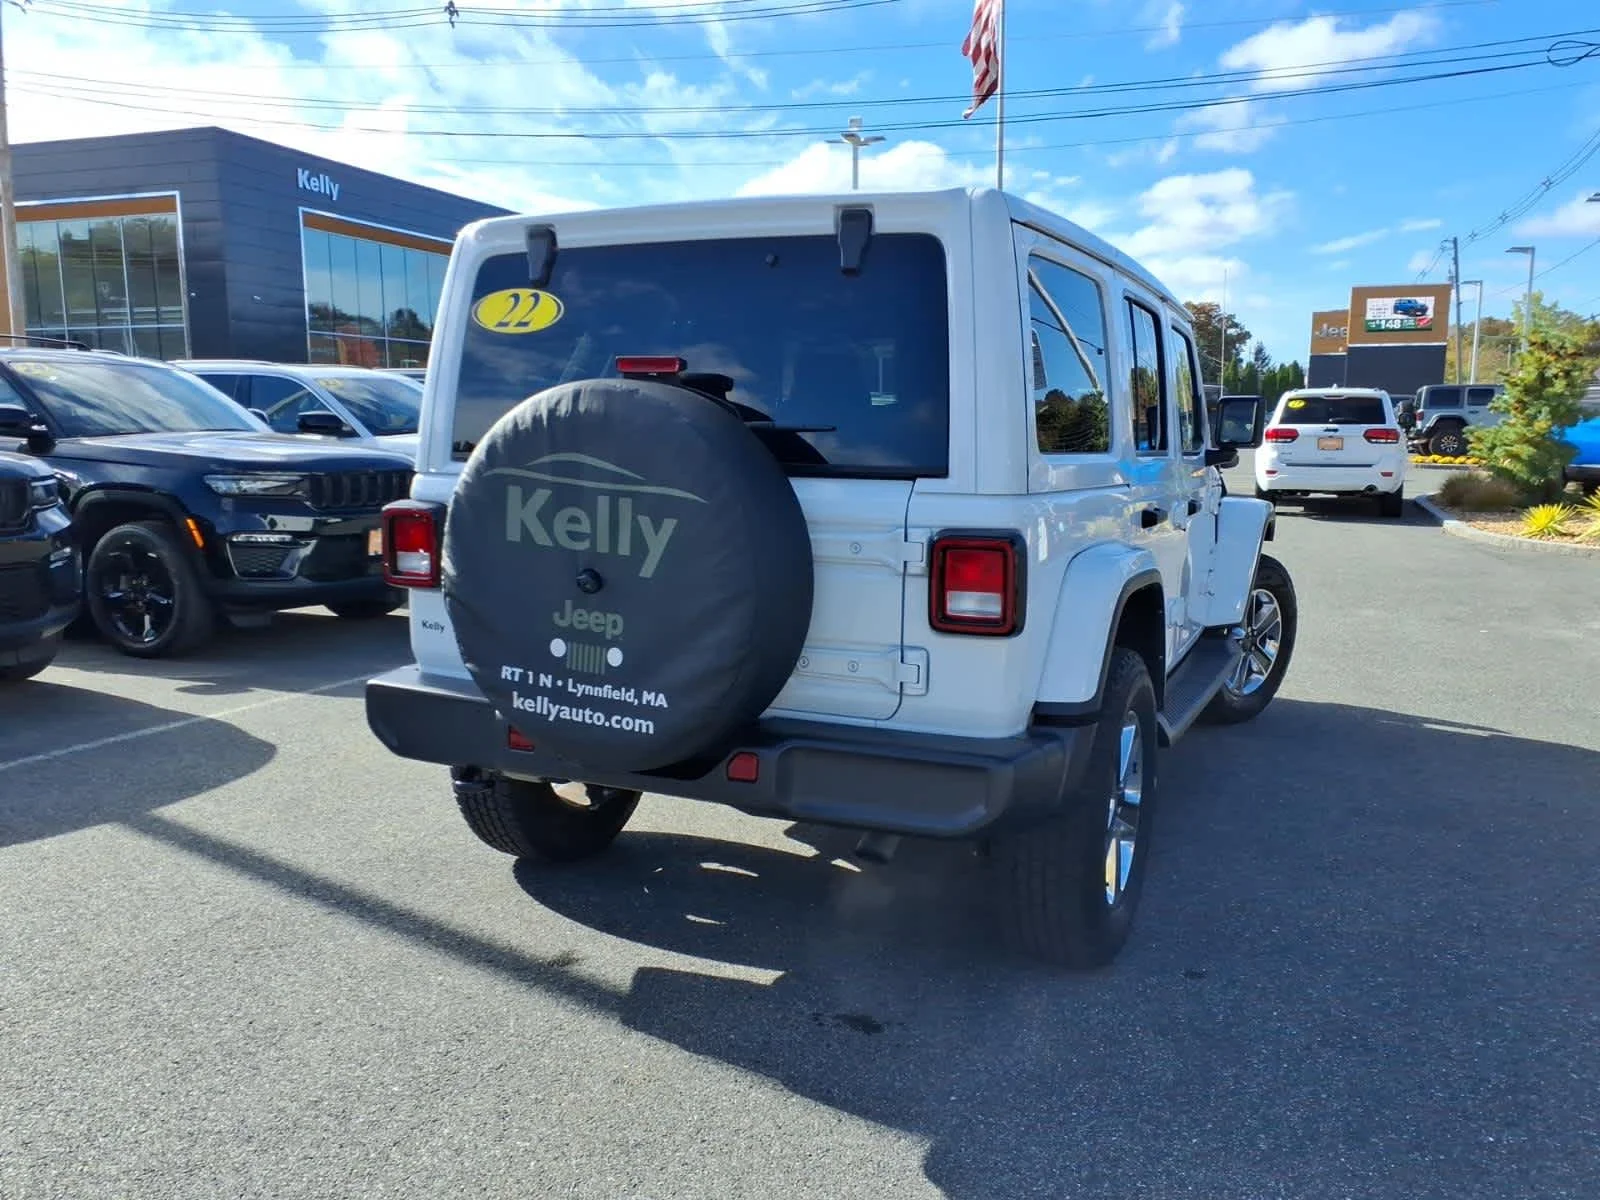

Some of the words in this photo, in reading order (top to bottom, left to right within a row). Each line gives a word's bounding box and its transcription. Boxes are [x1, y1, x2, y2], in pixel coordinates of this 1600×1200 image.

[297, 167, 340, 201] Kelly
[495, 292, 541, 328] 22
[505, 484, 678, 578] Kelly
[421, 620, 446, 633] Kelly
[552, 599, 624, 641] Jeep
[500, 665, 524, 682] RT
[527, 671, 534, 685] 1
[538, 673, 553, 689] N
[567, 678, 639, 706] Lynnfield,
[641, 690, 669, 708] MA
[511, 690, 655, 735] kellyauto.com
